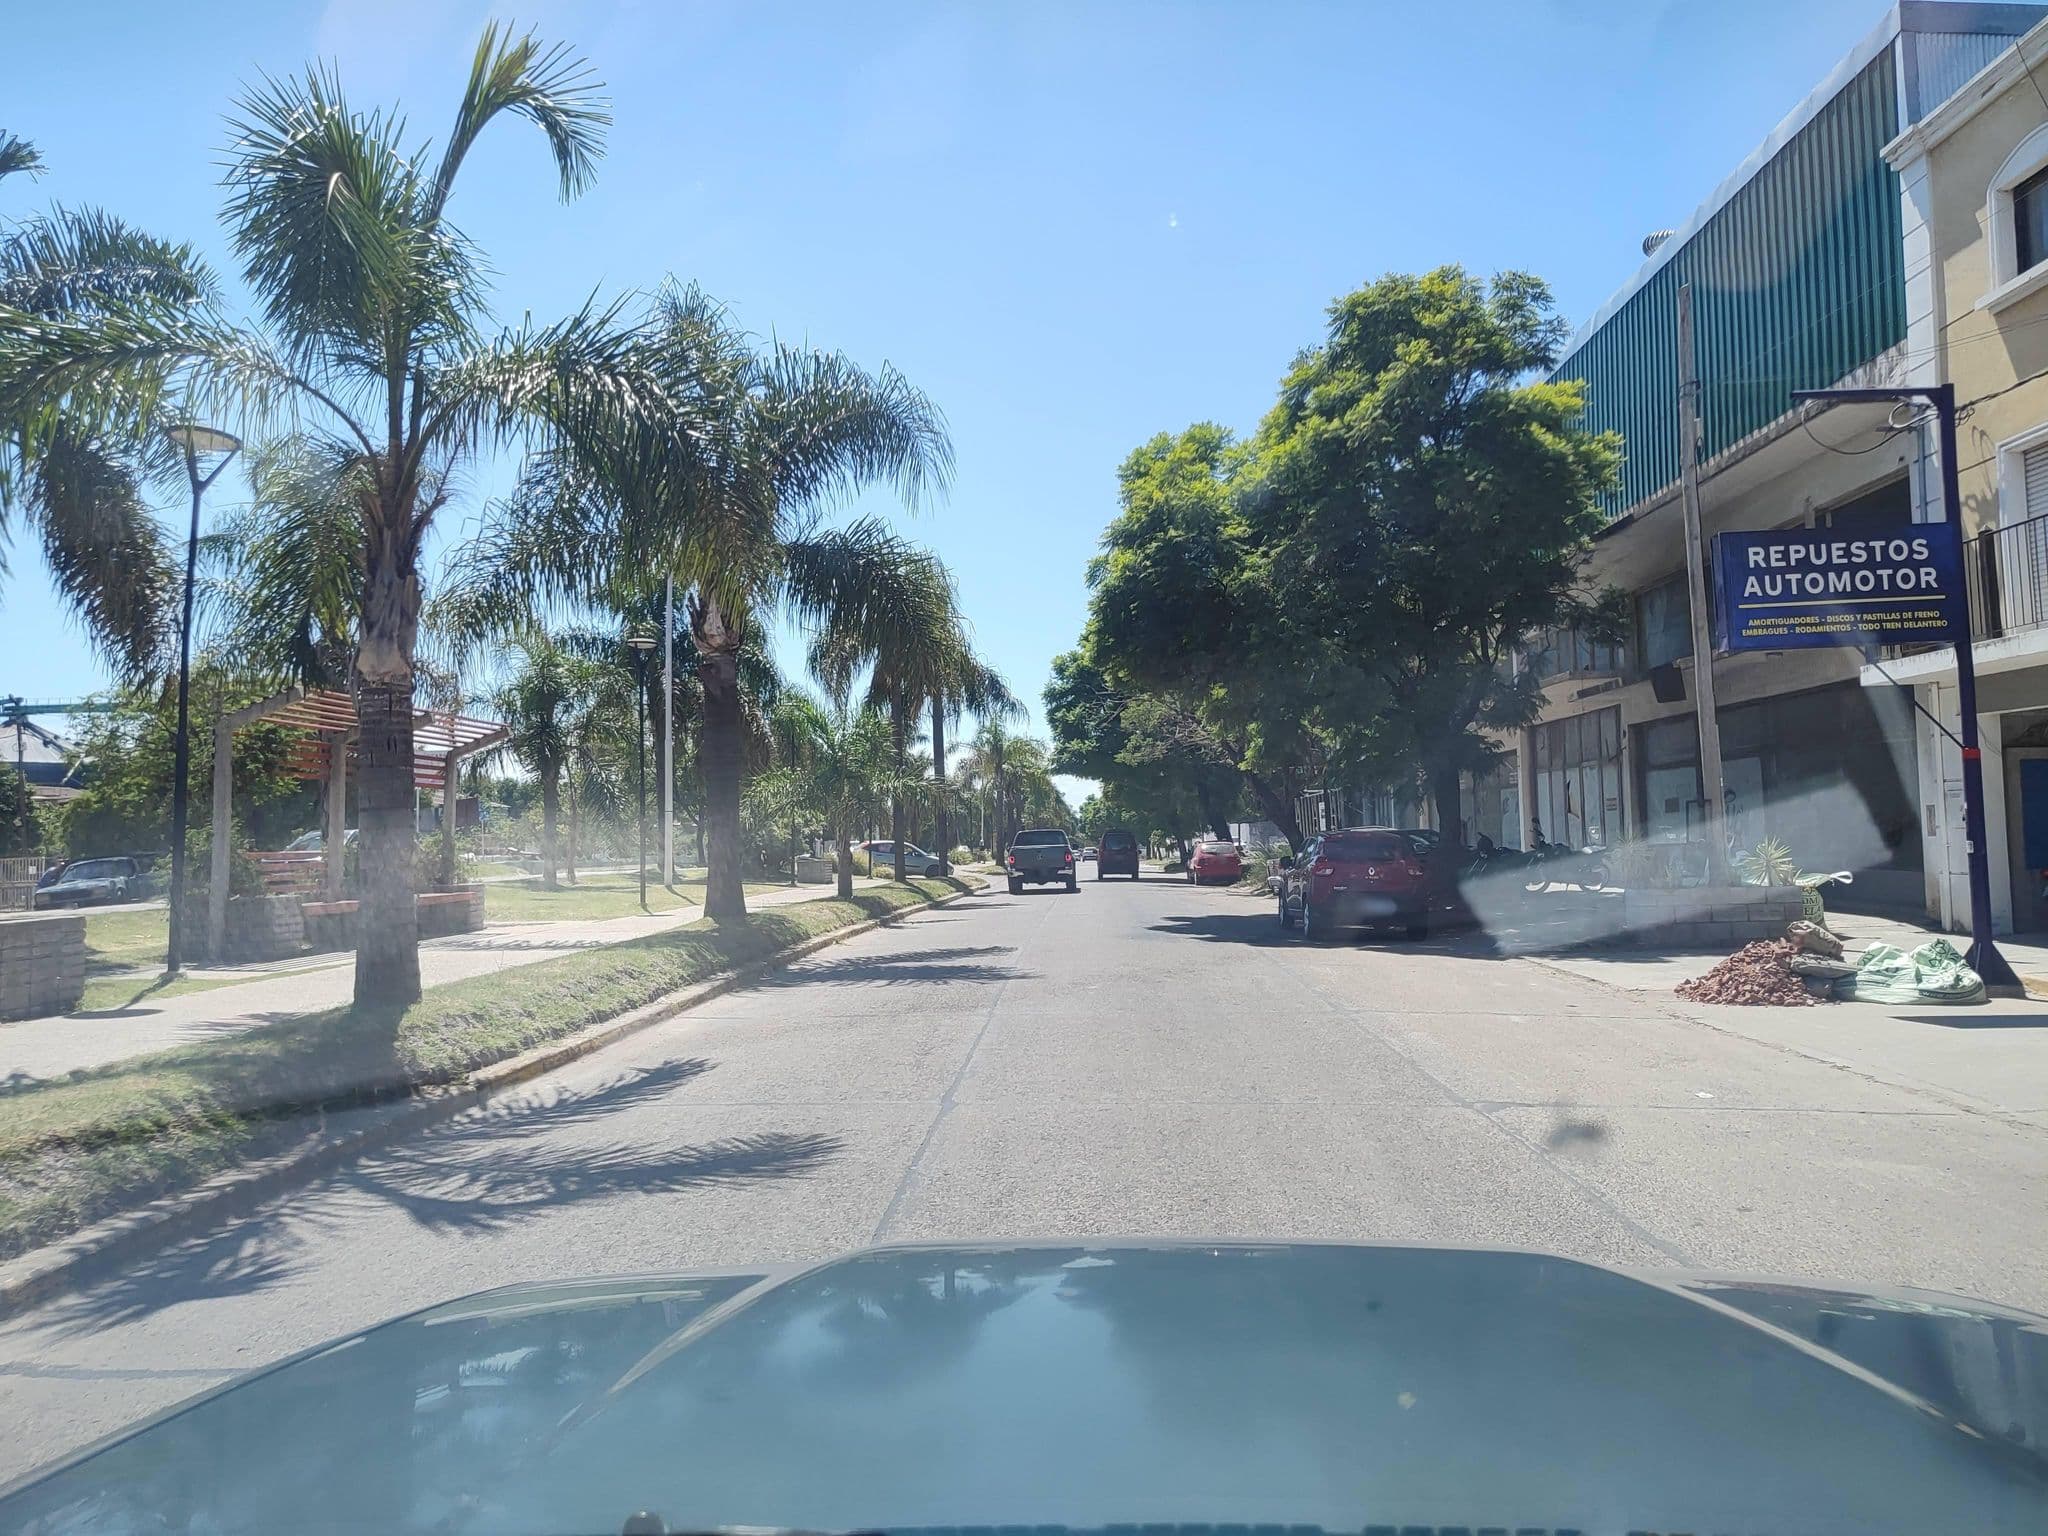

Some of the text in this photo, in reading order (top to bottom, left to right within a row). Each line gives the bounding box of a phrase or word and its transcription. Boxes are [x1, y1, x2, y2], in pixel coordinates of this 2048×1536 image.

[1748, 539, 1929, 568] REPUESTOS
[1743, 567, 1938, 597] AUTOMOTOR
[1742, 627, 1788, 636] EMBRAGUES
[1795, 624, 1851, 634] RODAMIENTOS
[1858, 622, 1880, 631] TODO
[1882, 621, 1901, 629] TREN
[1903, 620, 1948, 629] DELANTERO
[1748, 616, 1820, 626] AMORTIGUADORES
[1827, 614, 1854, 624] DISCOS
[1863, 612, 1900, 621] PASTILLAS
[1902, 611, 1912, 619] DE
[1914, 610, 1940, 618] FRENO
